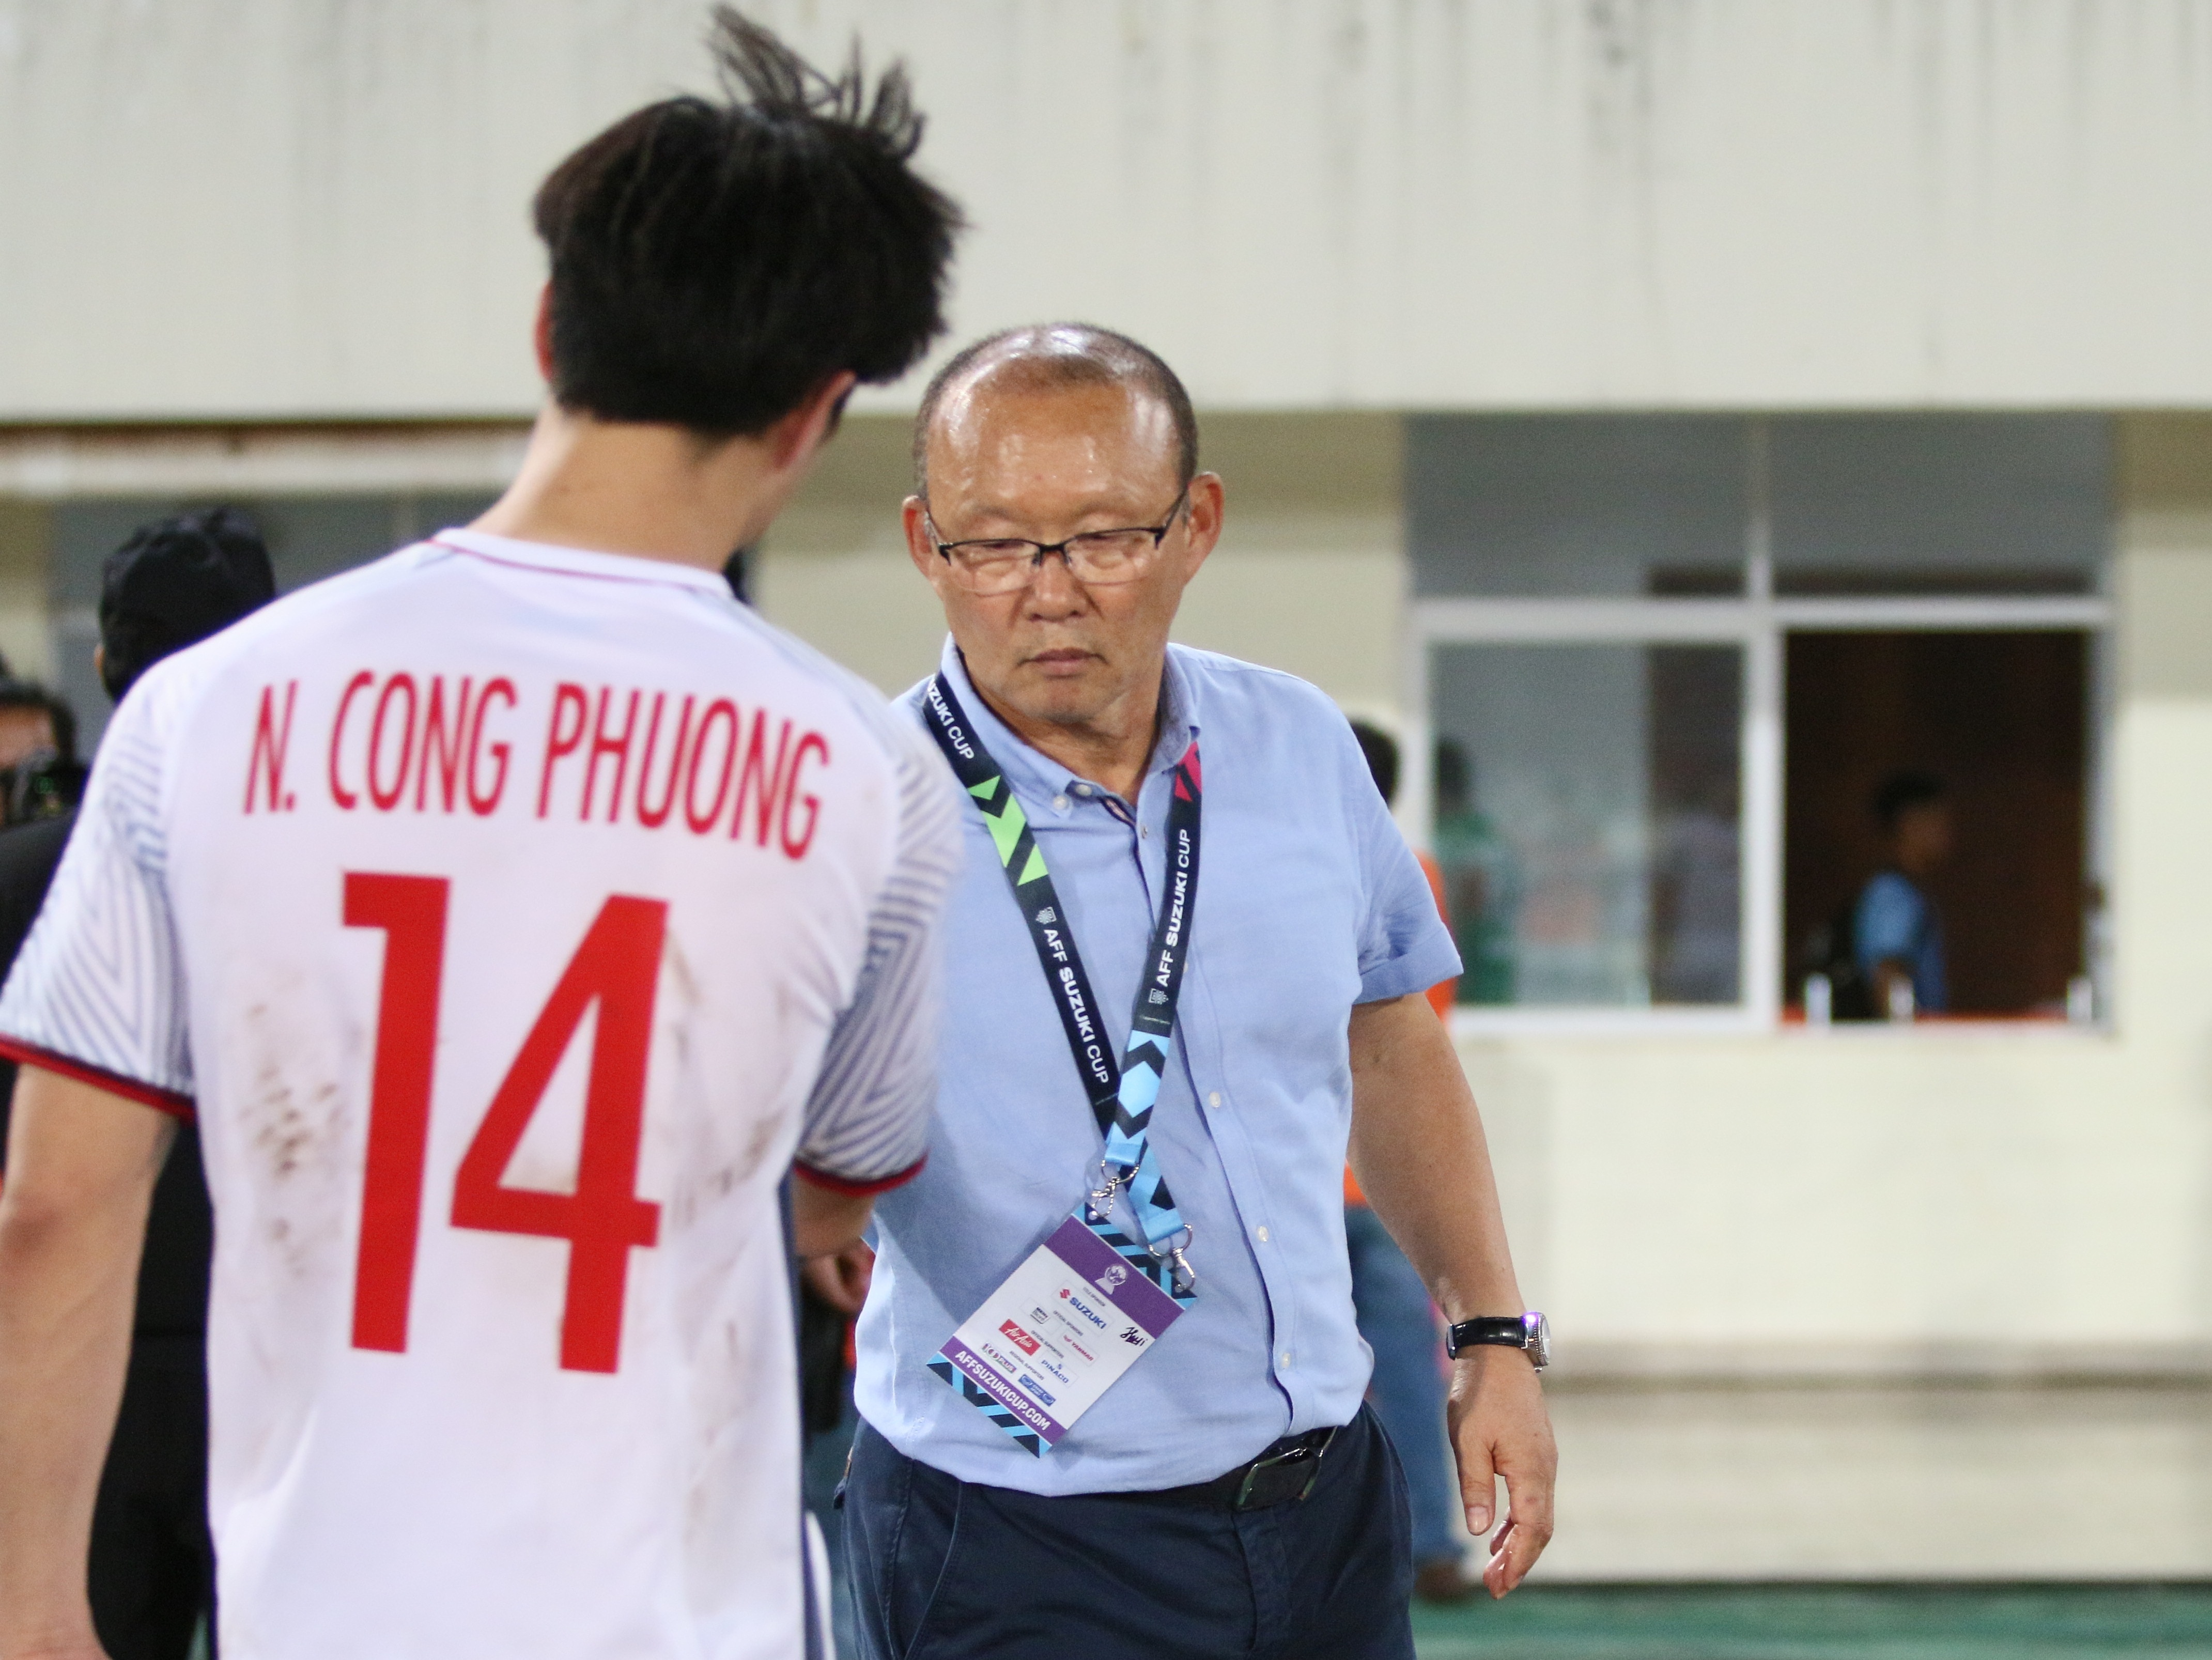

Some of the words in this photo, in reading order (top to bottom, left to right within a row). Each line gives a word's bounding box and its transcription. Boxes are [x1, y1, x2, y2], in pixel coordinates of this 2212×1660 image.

[244, 679, 299, 815] N.
[328, 670, 518, 818] CONG
[536, 681, 830, 862] PHUONG
[948, 726, 974, 759] CUP
[1156, 949, 1173, 987] AFF
[1166, 871, 1187, 947] SUZUKI
[1178, 829, 1190, 868] CUP
[1044, 929, 1068, 962] AFF
[1059, 967, 1095, 1042] SUZUKI
[1087, 1045, 1109, 1083] CUP
[340, 869, 671, 1376] 14
[1070, 1297, 1107, 1330] SUZUKI
[1071, 1342, 1094, 1361] YANMAR
[955, 1350, 1051, 1431] AFFSUZUKICUP.COM
[1041, 1360, 1069, 1384] PINACO
